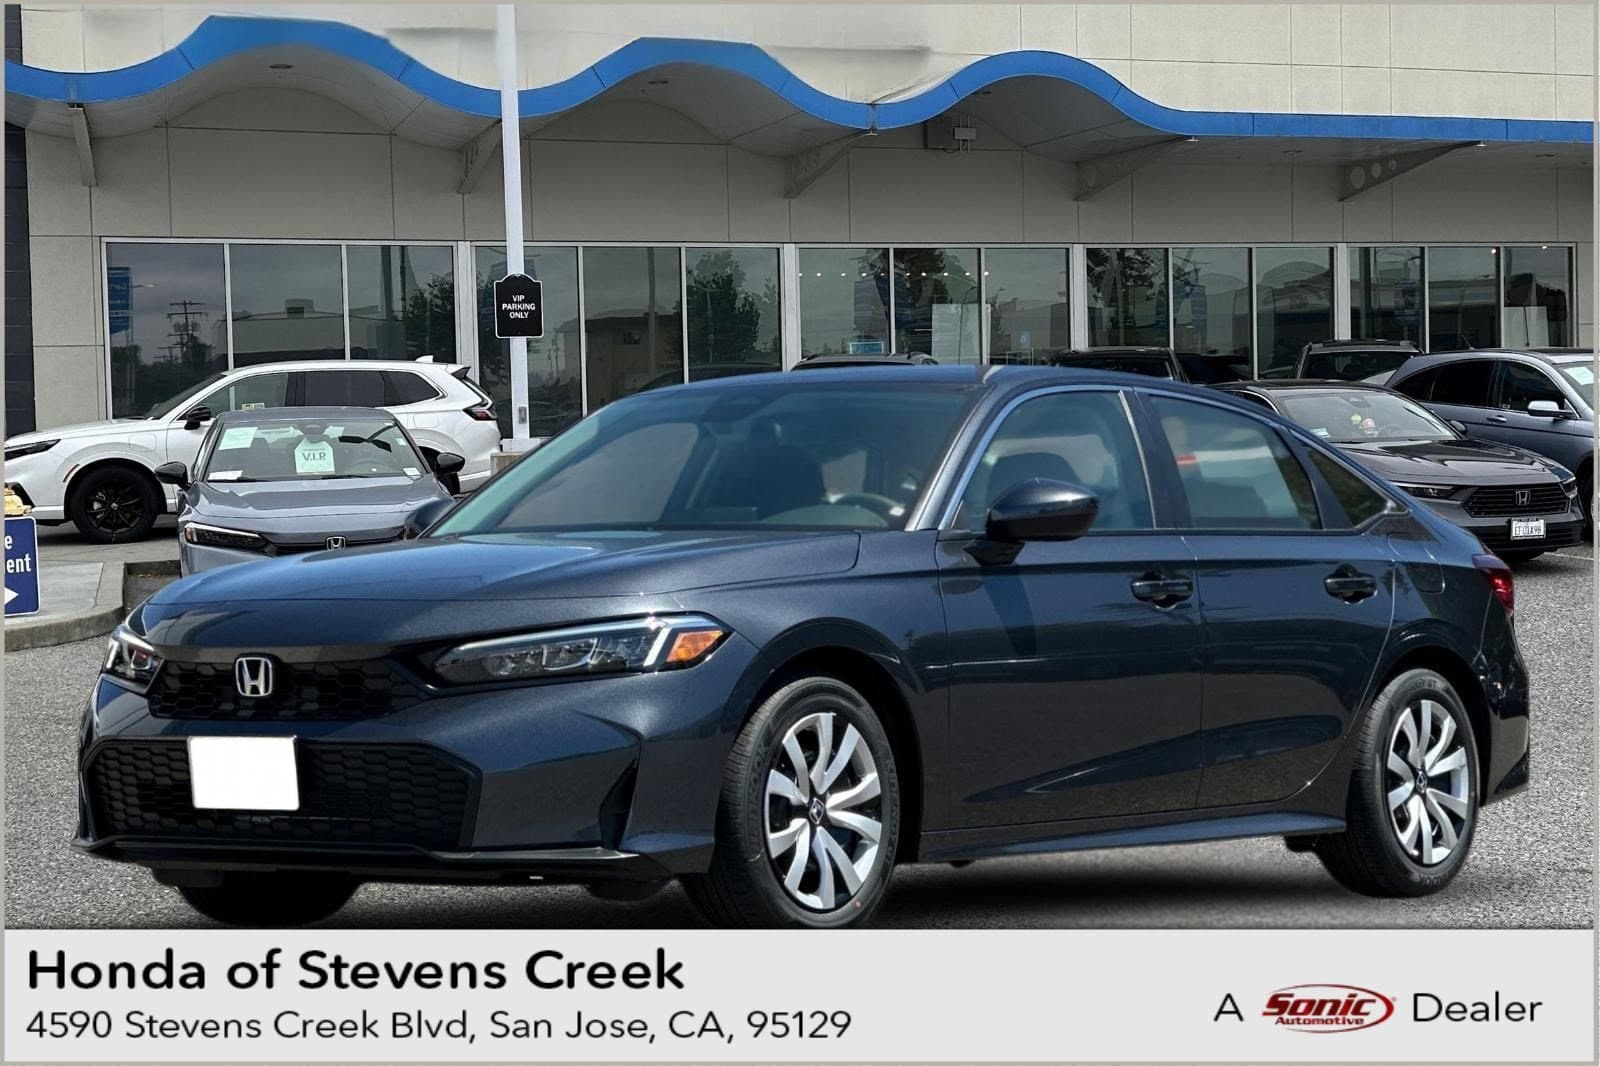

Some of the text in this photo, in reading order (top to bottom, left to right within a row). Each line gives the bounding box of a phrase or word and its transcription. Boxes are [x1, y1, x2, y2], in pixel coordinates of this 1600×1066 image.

[512, 294, 525, 302] VIP
[502, 303, 536, 311] PARKING
[509, 311, 529, 319] ONLY
